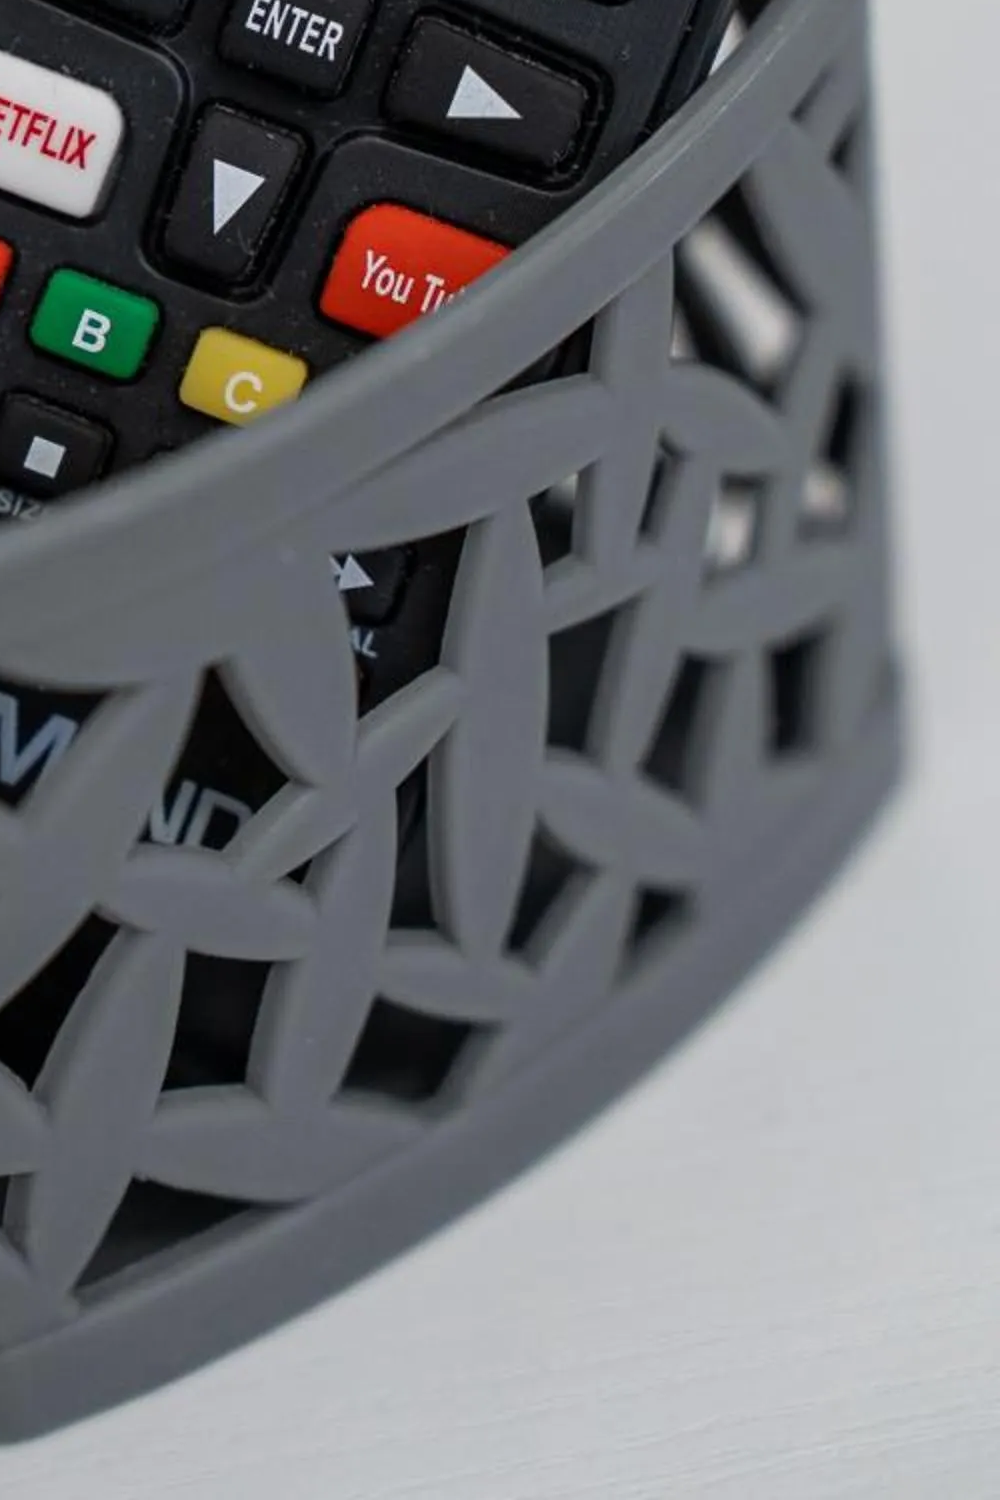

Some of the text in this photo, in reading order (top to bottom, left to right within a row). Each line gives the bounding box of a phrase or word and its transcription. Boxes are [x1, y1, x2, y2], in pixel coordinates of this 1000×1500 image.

[361, 249, 415, 304] You
[71, 308, 112, 354] B
[224, 370, 265, 415] C
